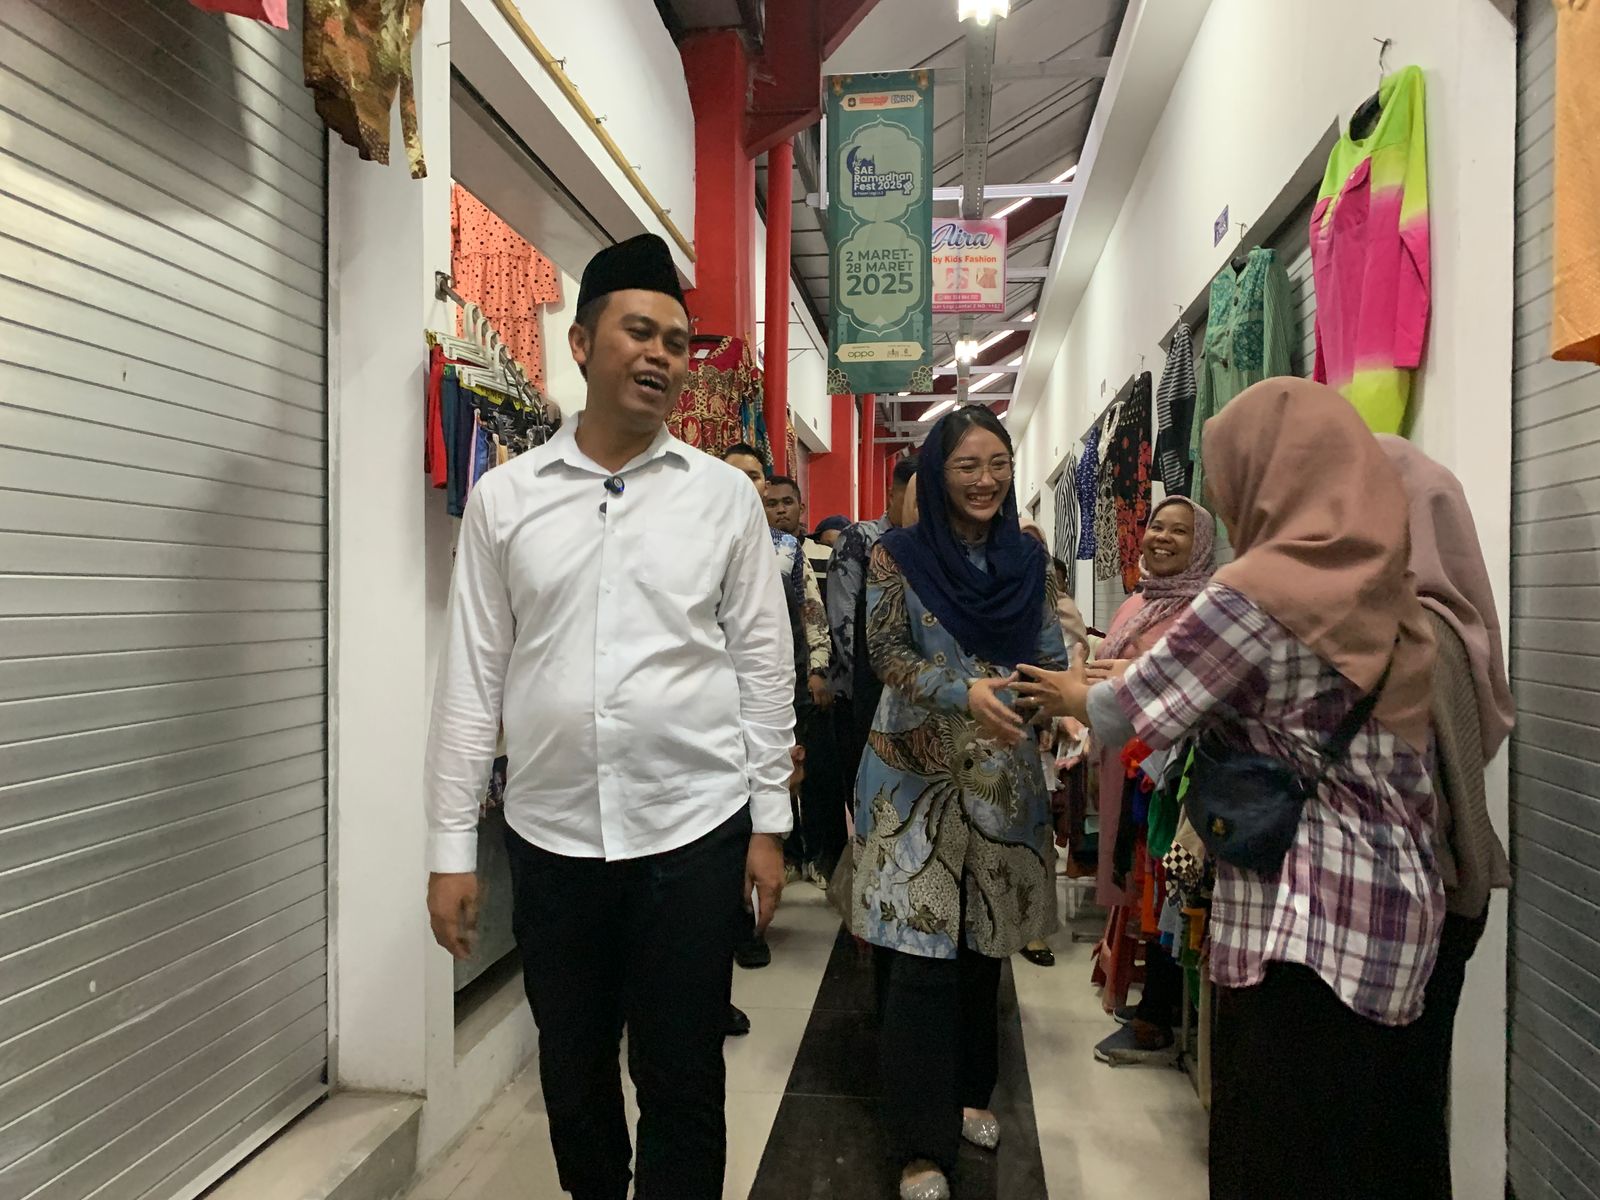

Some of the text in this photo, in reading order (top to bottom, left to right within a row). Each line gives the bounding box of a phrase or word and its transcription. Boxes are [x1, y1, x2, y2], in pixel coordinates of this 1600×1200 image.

[854, 166, 874, 175] SAE
[854, 172, 912, 183] Ramadhan
[854, 180, 903, 191] Fest 2025
[932, 223, 994, 250] Aira
[846, 248, 913, 262] 2 MARET-
[944, 255, 962, 263] Kids
[965, 255, 997, 263] Fashion
[846, 261, 914, 274] 28 MARET
[846, 272, 914, 296] 2025
[848, 350, 875, 359] oppo
